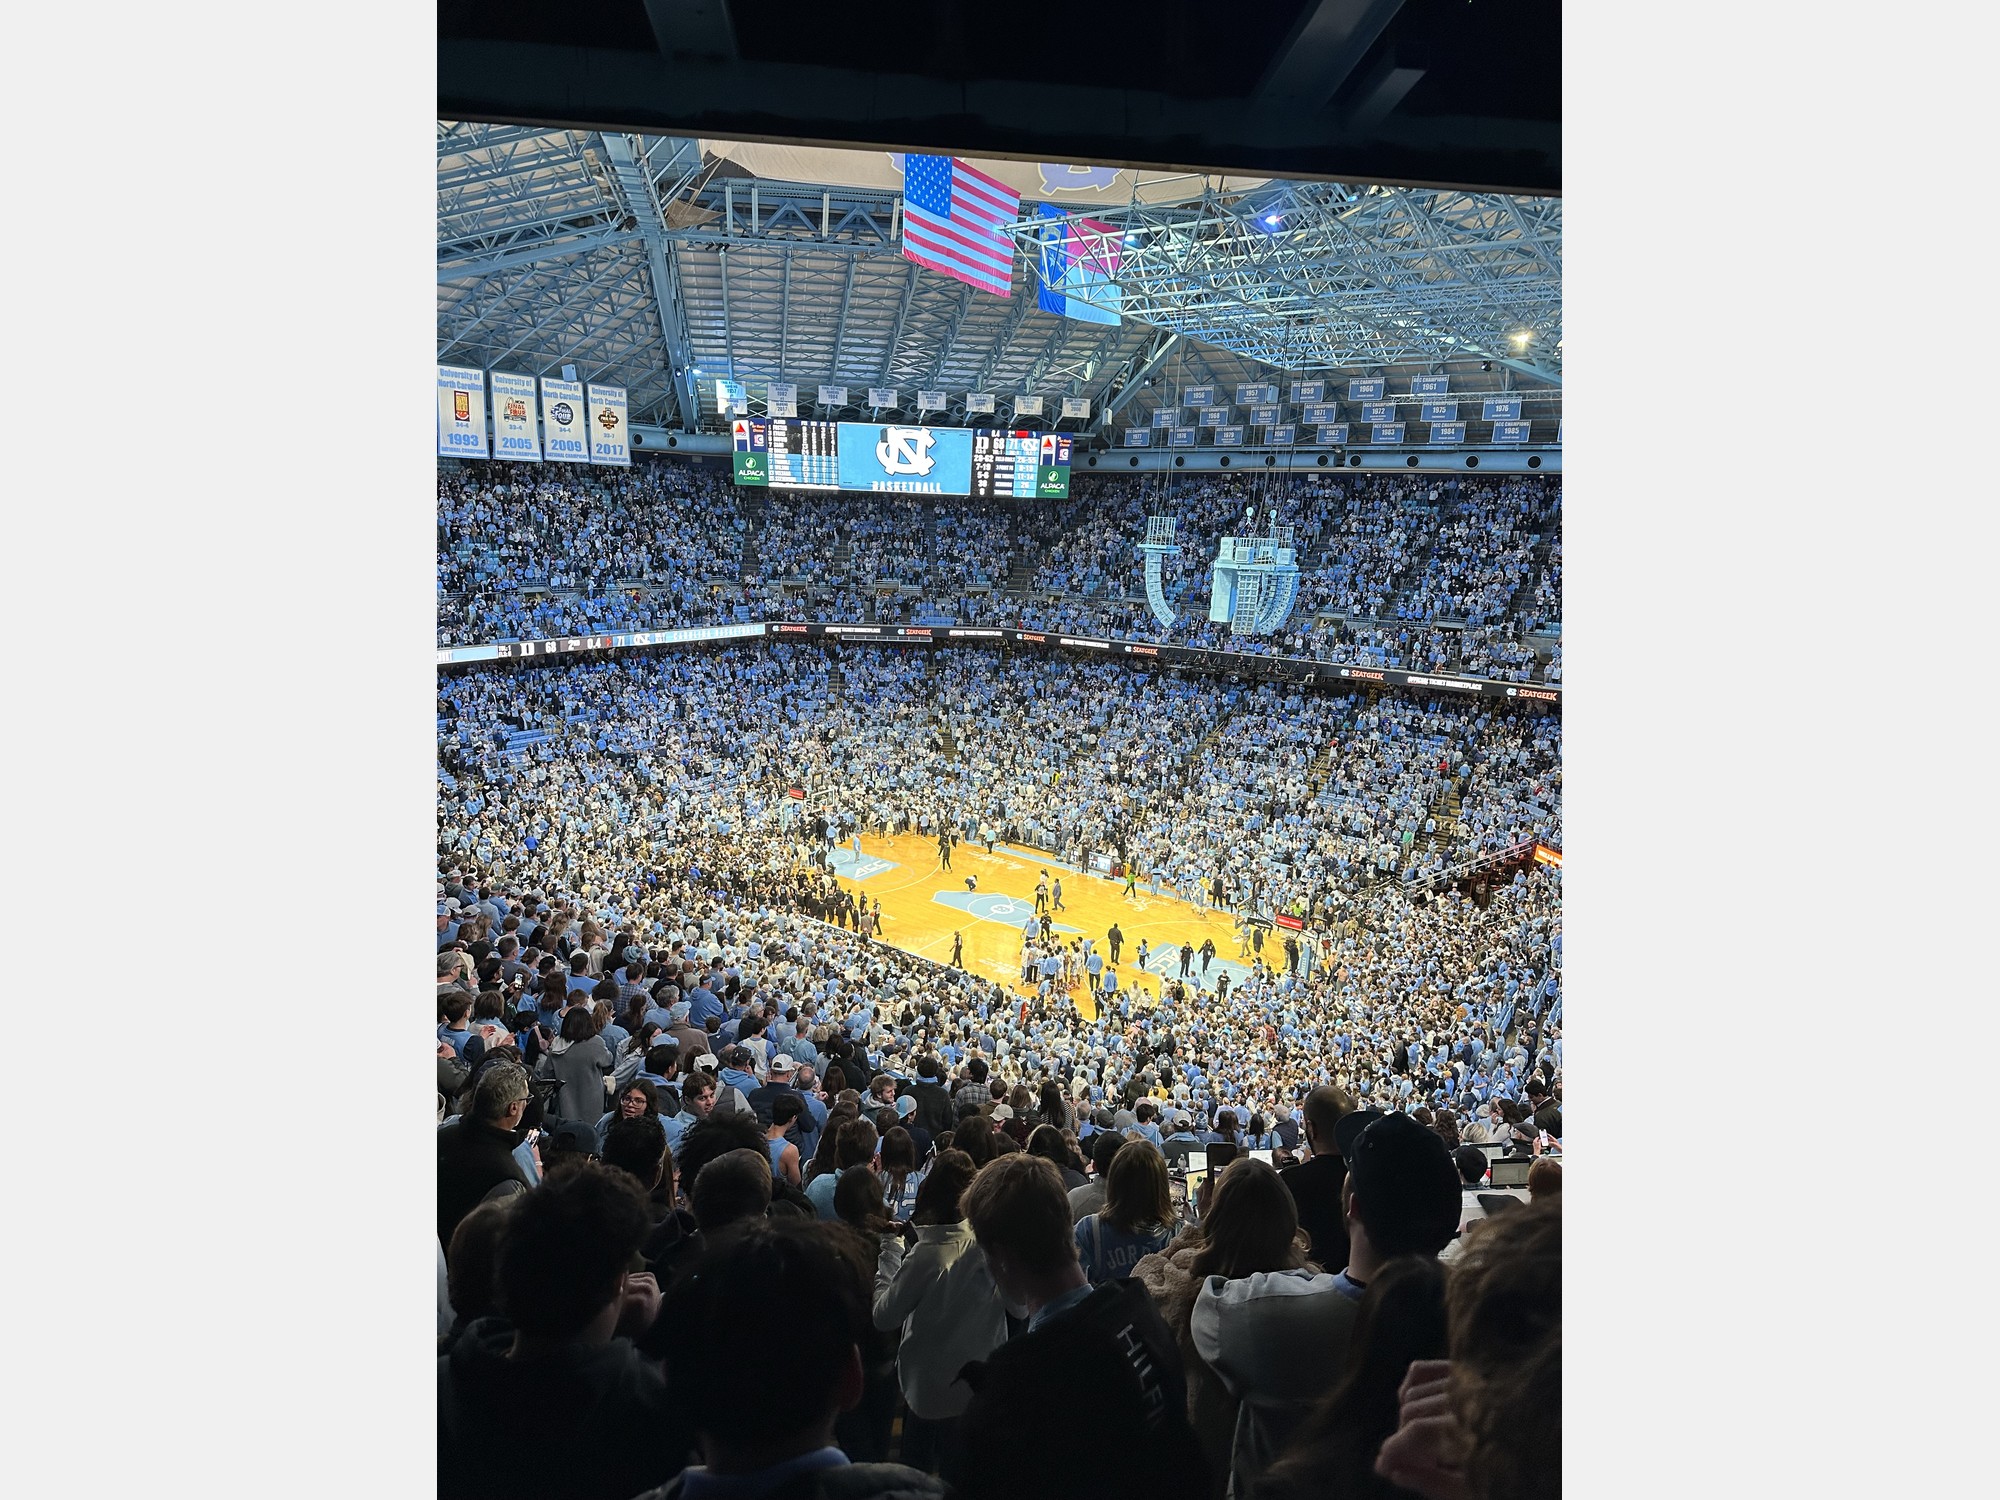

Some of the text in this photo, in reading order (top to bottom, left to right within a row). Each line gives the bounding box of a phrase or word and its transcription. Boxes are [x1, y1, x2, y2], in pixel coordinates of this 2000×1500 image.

[440, 368, 480, 380] University of
[438, 380, 483, 391] North Carolina
[495, 376, 532, 387] University of
[545, 381, 573, 391] University
[494, 386, 534, 397] North Carolina
[543, 390, 582, 401] North Carolina
[592, 387, 617, 398] University
[605, 398, 626, 407] Carolina
[447, 433, 479, 447] 1993
[502, 437, 532, 450] 2005
[551, 439, 582, 452] 2009
[993, 438, 1005, 449] 68
[1008, 440, 1018, 450] 71
[596, 443, 624, 456] 2017
[871, 480, 942, 493] BASKETBALL
[780, 624, 807, 633] SEATGEEK
[906, 628, 932, 636] SEATGEEK
[1023, 634, 1045, 642] SEATGEEK
[545, 641, 557, 653] 68
[587, 638, 602, 649] 0.4
[617, 636, 625, 646] 71
[1132, 646, 1158, 655] SEATGEEK
[1351, 669, 1385, 681] SEATGEEK
[1519, 689, 1558, 702] SEATGEEK
[854, 860, 890, 878] ACC
[971, 995, 978, 1003] 2
[886, 1183, 915, 1194] JAN
